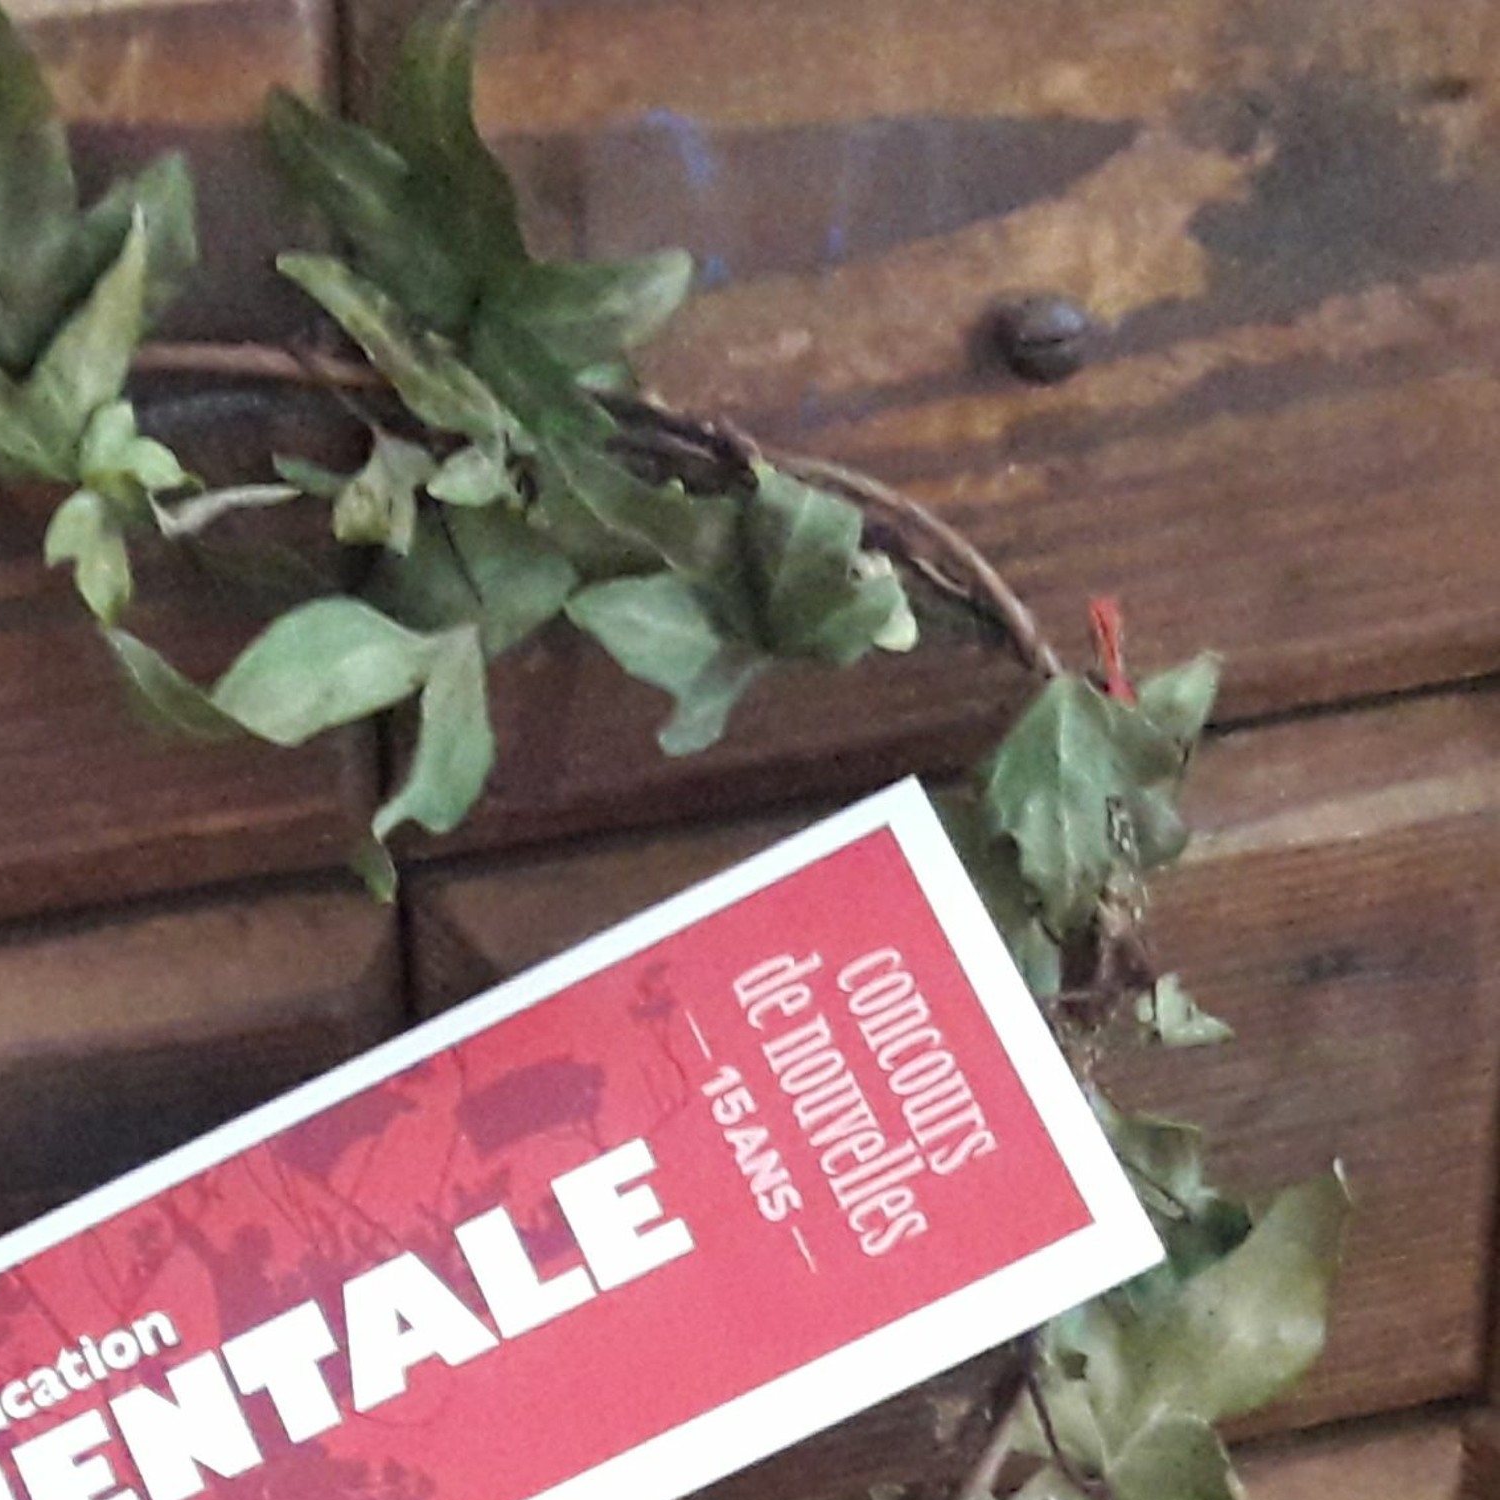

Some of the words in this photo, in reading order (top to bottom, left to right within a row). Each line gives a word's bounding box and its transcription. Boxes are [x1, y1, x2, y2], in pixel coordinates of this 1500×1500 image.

[732, 951, 822, 1030] de
[700, 1064, 757, 1126] 15
[838, 946, 997, 1176] concours
[723, 1126, 804, 1222] ANS
[762, 1012, 928, 1257] nouvelles
